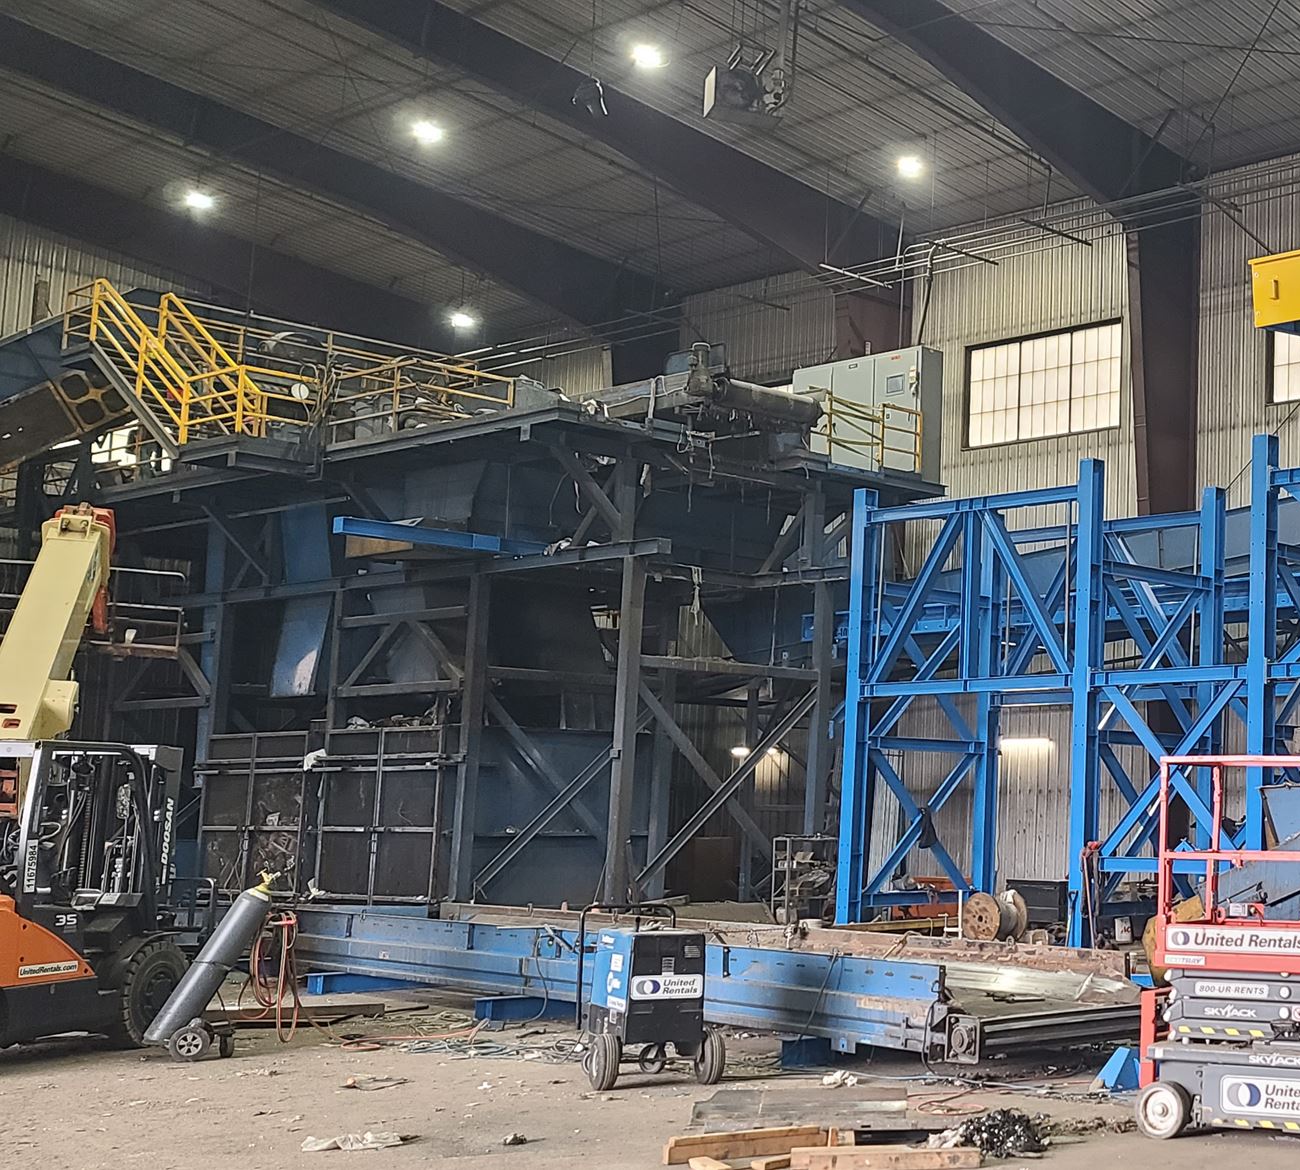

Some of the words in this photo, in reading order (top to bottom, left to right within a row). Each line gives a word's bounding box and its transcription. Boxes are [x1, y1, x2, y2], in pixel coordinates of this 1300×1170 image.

[160, 797, 174, 865] DOOSAN
[26, 844, 38, 889] 11675984
[55, 914, 77, 927] 35
[1194, 932, 1246, 947] United
[19, 964, 78, 976] UnitedRentals.com
[663, 979, 695, 987] United
[662, 987, 698, 995] Rentals
[1204, 1004, 1257, 1018] SKYJACK
